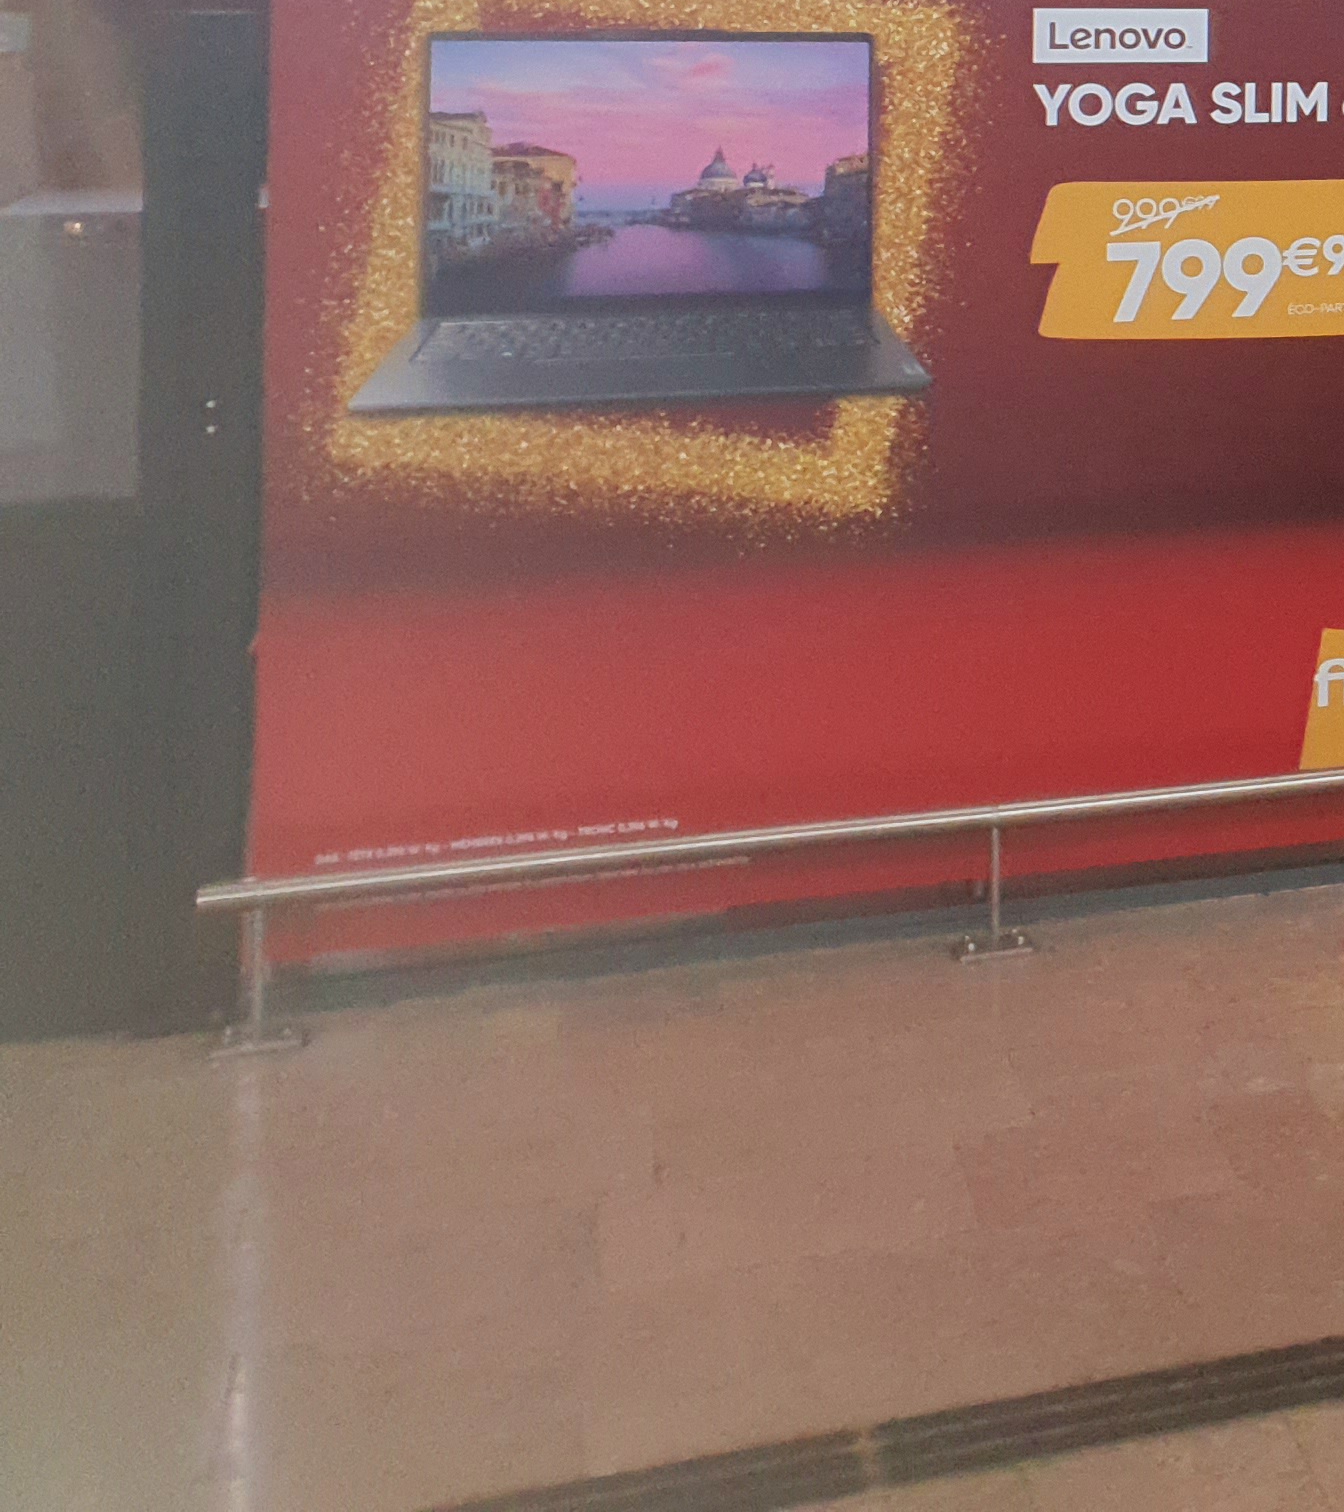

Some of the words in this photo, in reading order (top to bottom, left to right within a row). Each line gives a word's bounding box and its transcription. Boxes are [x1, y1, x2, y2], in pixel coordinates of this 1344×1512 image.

[1049, 21, 1187, 50] Lenovo
[1033, 82, 1198, 127] YOGA
[1210, 81, 1328, 124] SLIM
